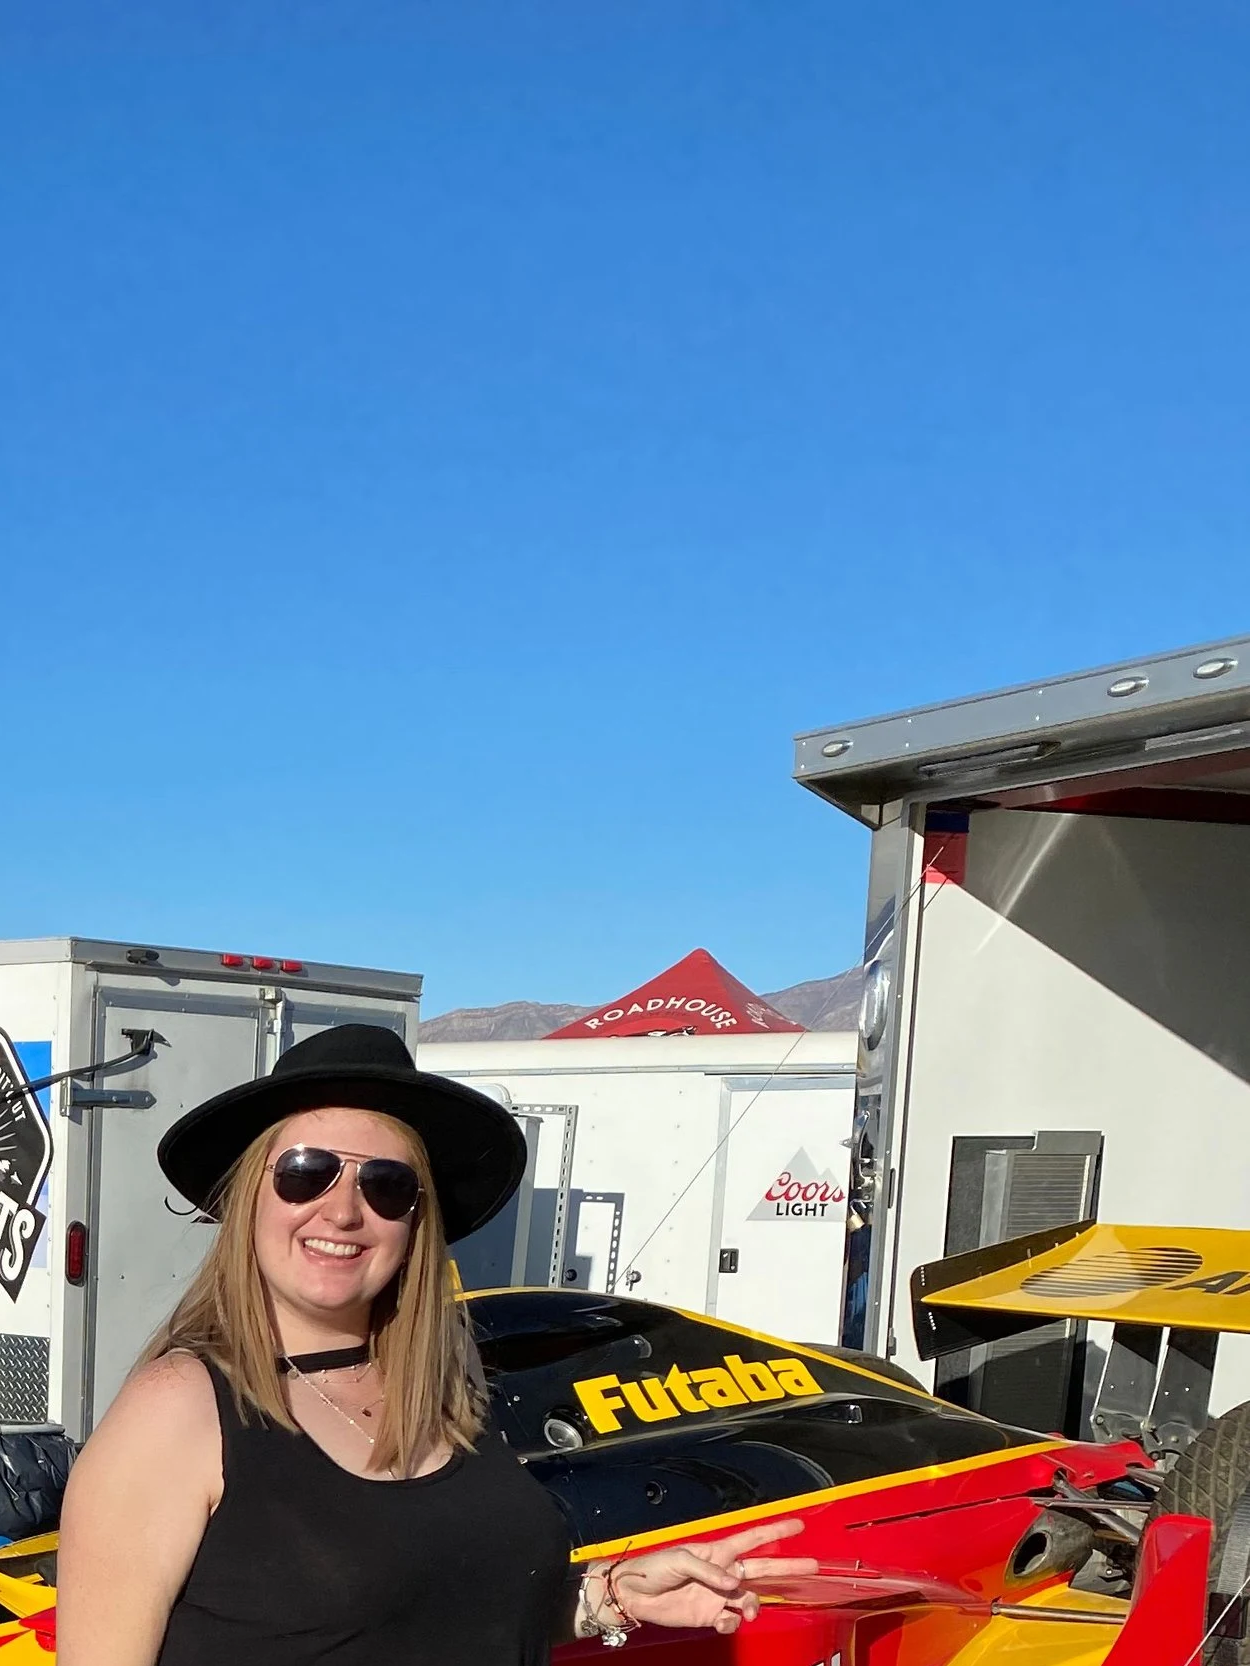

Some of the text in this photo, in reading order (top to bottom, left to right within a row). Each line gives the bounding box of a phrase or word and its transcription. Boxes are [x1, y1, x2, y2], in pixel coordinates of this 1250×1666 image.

[584, 996, 738, 1029] ROADHOUSE
[11, 1100, 26, 1121] UT
[765, 1171, 846, 1202] Coors
[775, 1202, 828, 1217] LIGHT
[572, 1354, 825, 1435] Futaba
